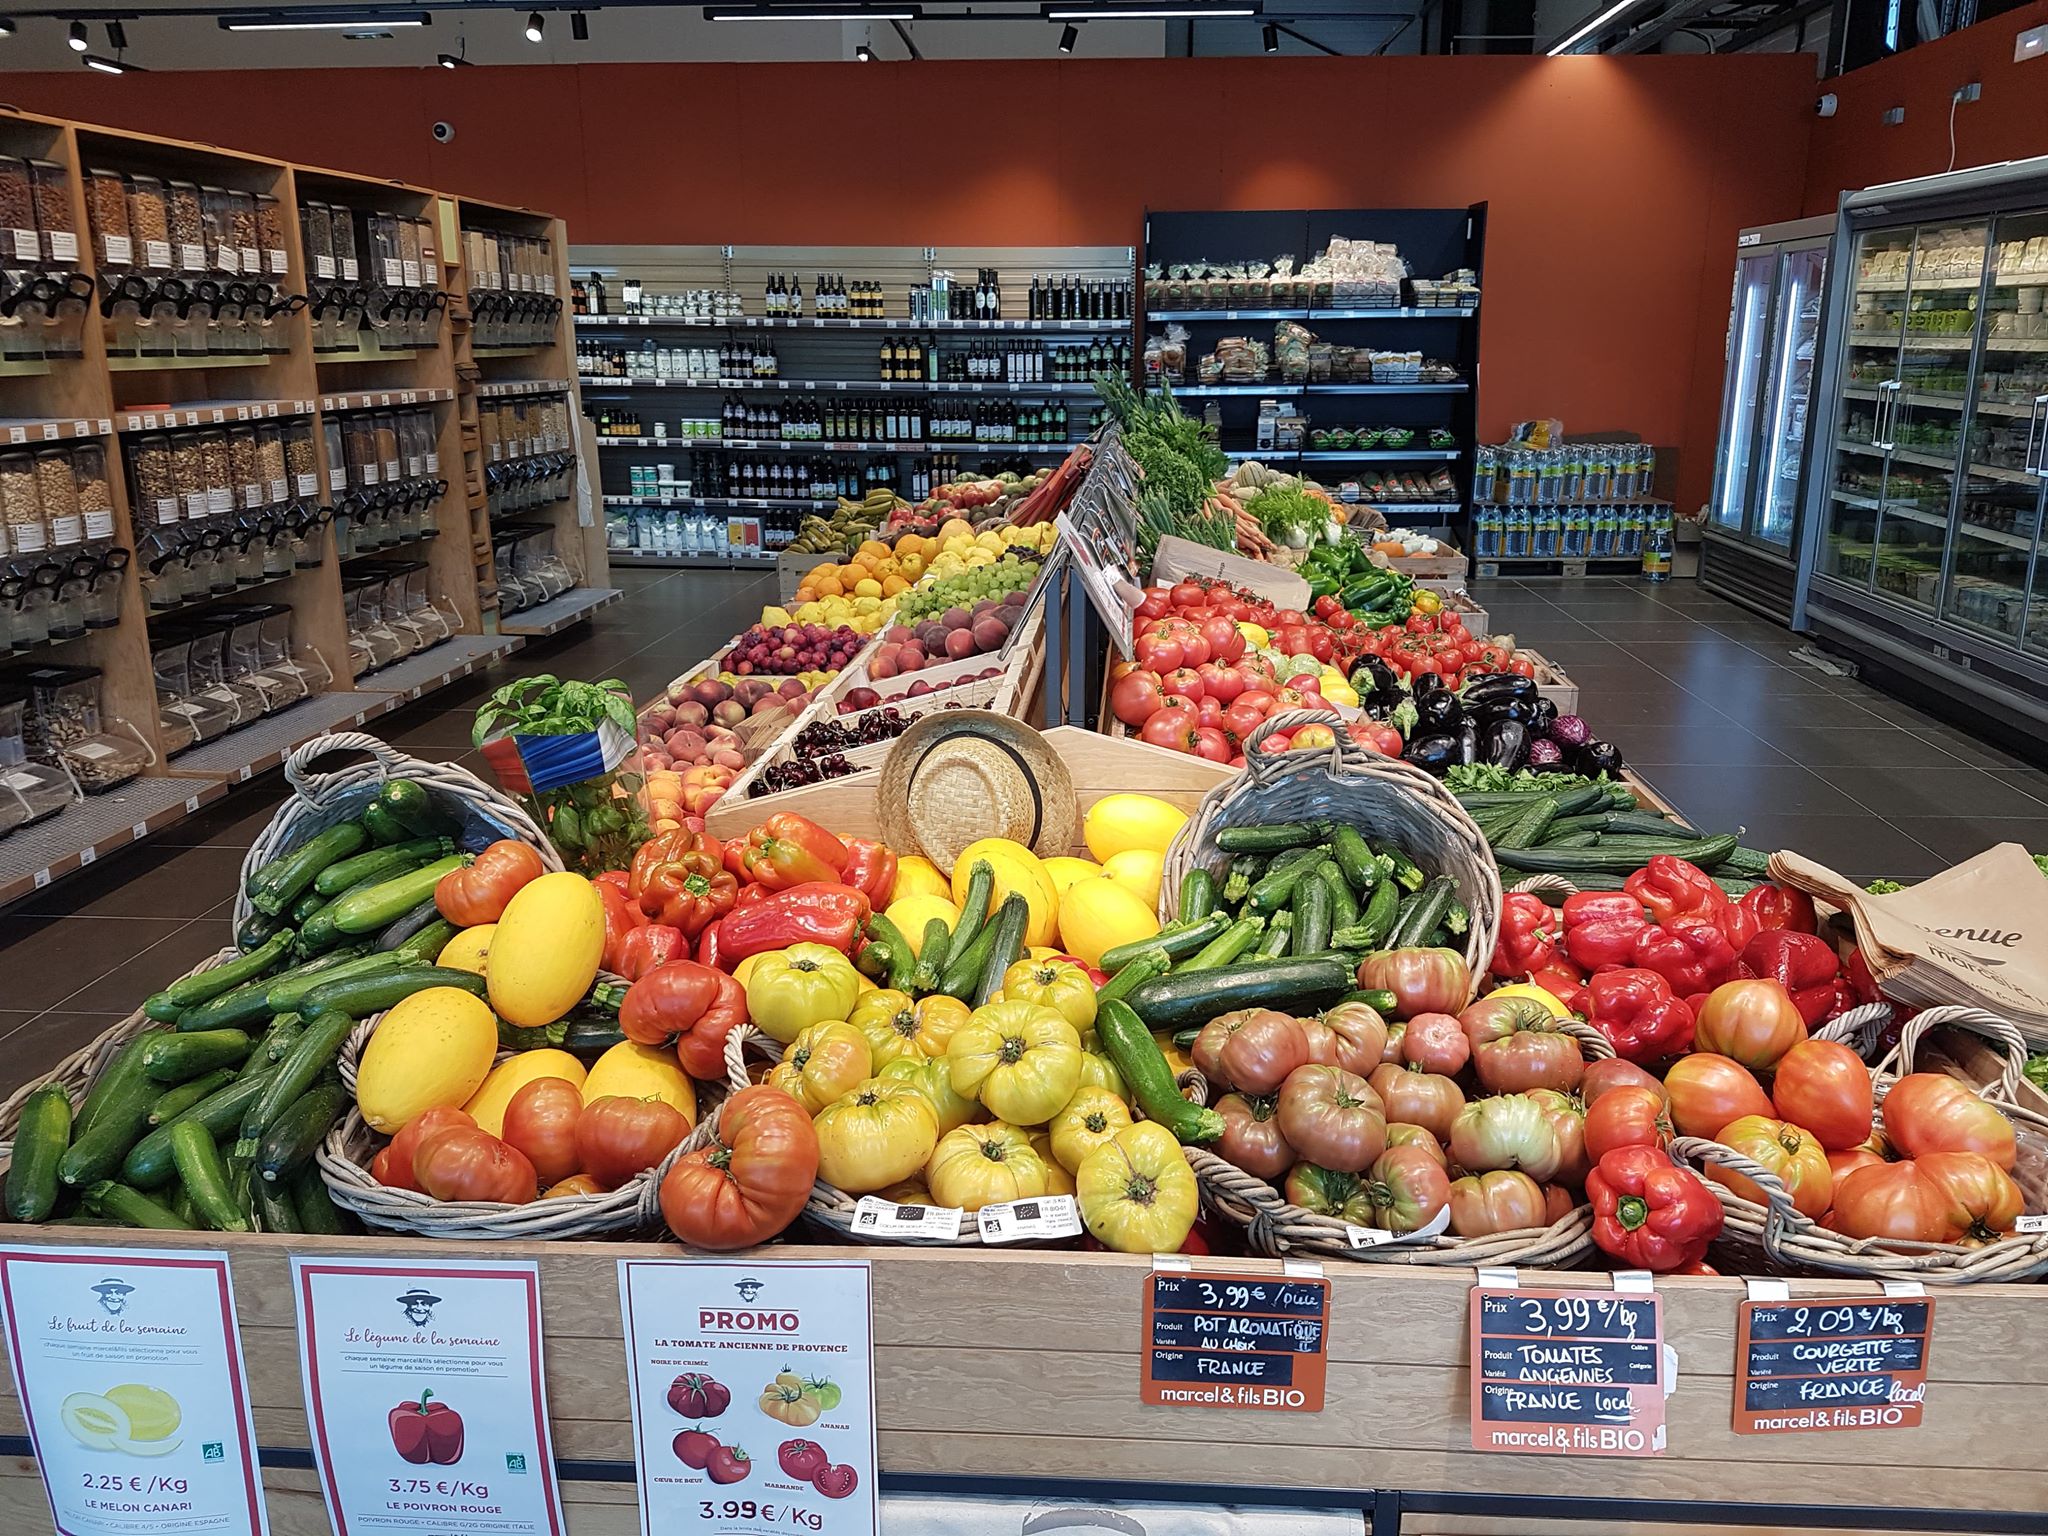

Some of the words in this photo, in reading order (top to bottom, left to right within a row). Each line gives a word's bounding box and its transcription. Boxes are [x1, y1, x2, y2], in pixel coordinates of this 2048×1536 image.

[1158, 1281, 1179, 1291] Prix
[1484, 1301, 1507, 1313] Prix
[699, 1311, 800, 1331] PROMO
[1754, 1312, 1777, 1323] Prix
[48, 1316, 64, 1331] Le
[67, 1317, 98, 1333] fruit
[101, 1320, 117, 1333] de
[119, 1319, 135, 1334] la
[137, 1325, 188, 1335] semaine
[1156, 1323, 1183, 1331] Produit
[344, 1328, 361, 1343] Le
[364, 1328, 409, 1348] légume
[412, 1332, 428, 1344] de
[430, 1331, 446, 1345] la
[449, 1336, 501, 1347] semaine
[655, 1339, 668, 1347] LA
[671, 1340, 716, 1348] TOMATE
[719, 1342, 773, 1350] ANCIENNE
[776, 1343, 789, 1351] DE
[1201, 1337, 1219, 1349] AU
[1485, 1351, 1512, 1360] Produit
[1751, 1353, 1780, 1361] Produit
[1156, 1352, 1183, 1361] Origine
[1197, 1358, 1266, 1376] FRANCE
[1816, 1357, 1884, 1375] VERTE
[1750, 1381, 1779, 1390] Origine
[1800, 1378, 1884, 1401] FRANCE
[1485, 1386, 1514, 1396] Origine
[1506, 1392, 1582, 1411] FRANCE
[82, 1473, 123, 1492] 2.25
[388, 1479, 431, 1494] 3.75
[764, 1482, 804, 1491] MARMANDE
[85, 1499, 97, 1509] LE
[100, 1502, 140, 1512] MELON
[143, 1502, 193, 1513] CANARI
[386, 1502, 400, 1510] LE
[404, 1503, 457, 1512] POIVRON
[461, 1506, 502, 1514] ROUGE
[161, 1521, 193, 1530] ORIGINE
[194, 1516, 231, 1527] ESPAGNE
